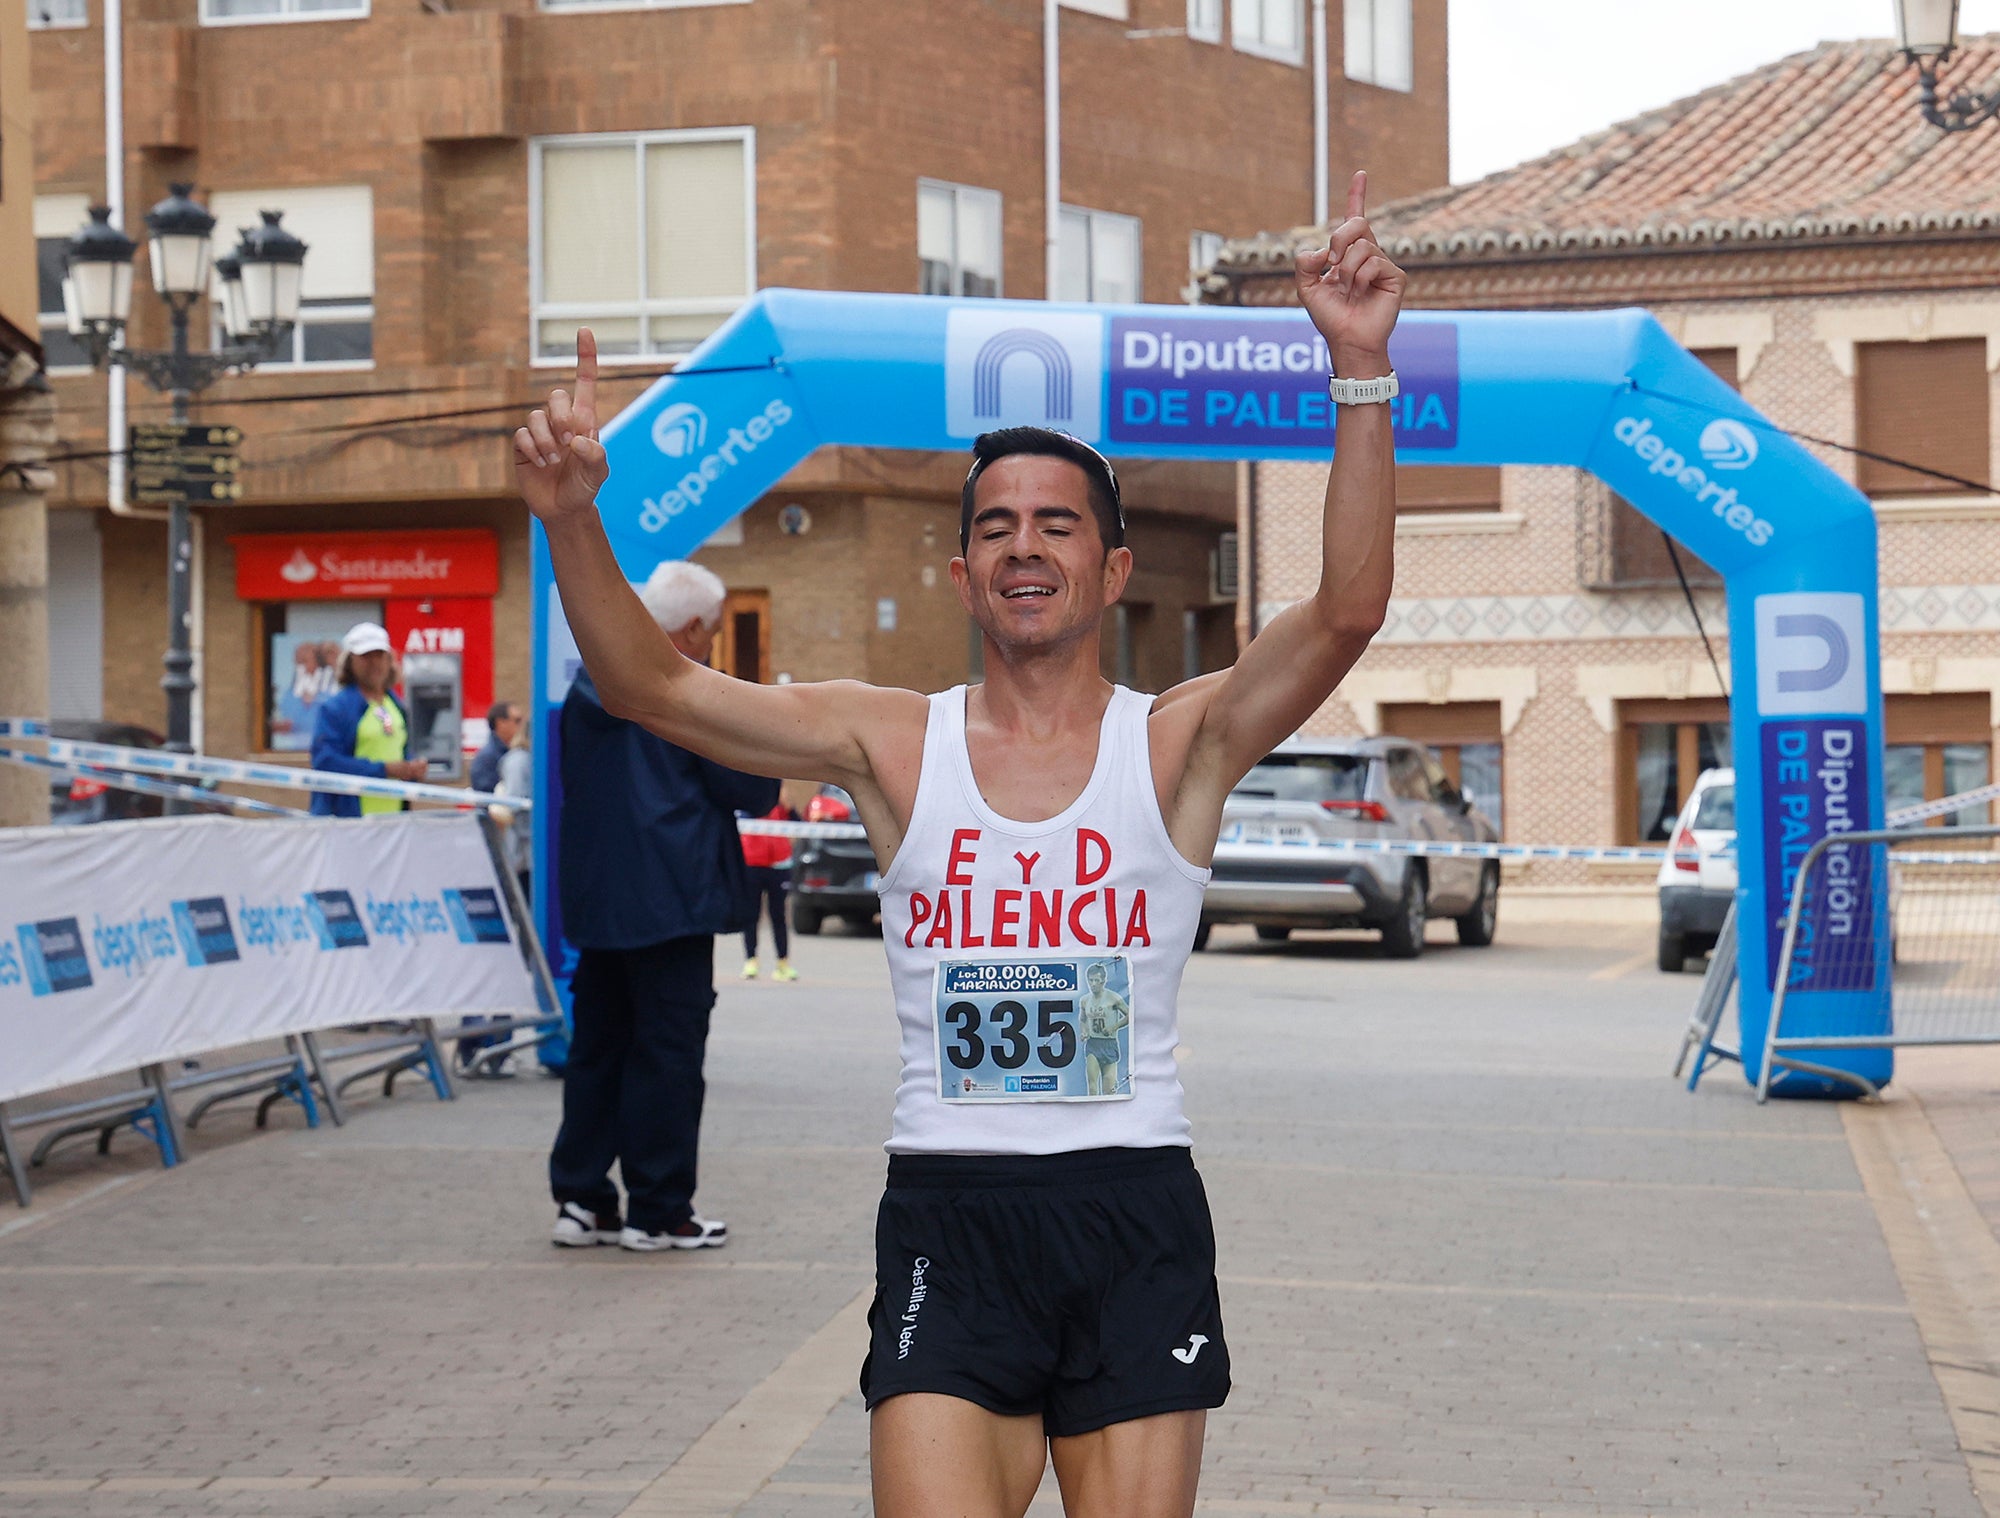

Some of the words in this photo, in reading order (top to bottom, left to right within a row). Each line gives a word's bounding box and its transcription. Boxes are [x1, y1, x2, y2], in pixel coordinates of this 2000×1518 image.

[1123, 331, 1333, 378] Diputaci
[1123, 387, 1190, 426] DE
[1205, 388, 1451, 431] PALEIA
[638, 399, 793, 534] deportes
[1613, 416, 1775, 547] deportes
[320, 550, 452, 582] Santander
[405, 627, 465, 652] ATM
[1777, 729, 1809, 785] DE
[945, 827, 983, 886] E
[1075, 827, 1112, 886] D
[904, 887, 1152, 949] PALENCIA
[953, 979, 1021, 991] MARIANO
[1025, 978, 1068, 990] HARO
[977, 965, 1040, 980] 10.000
[945, 999, 1077, 1071] 335
[907, 1256, 930, 1313] Castilla
[901, 1313, 918, 1322] y
